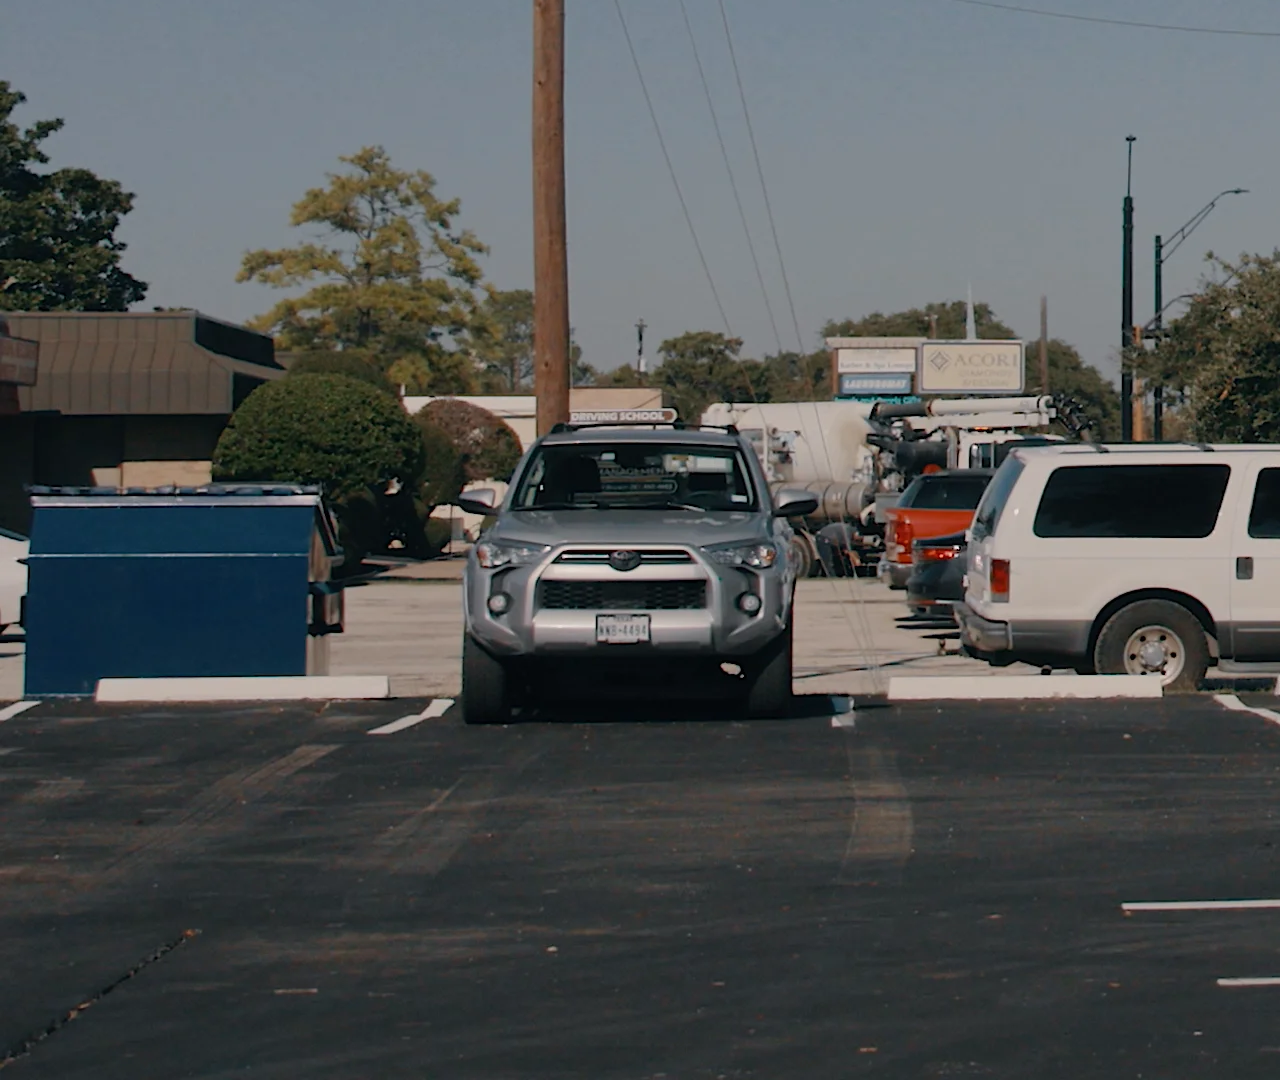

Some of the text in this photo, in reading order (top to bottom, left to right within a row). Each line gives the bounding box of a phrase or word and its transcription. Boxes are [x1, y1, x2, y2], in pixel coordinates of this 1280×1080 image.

[954, 353, 1018, 367] ACORI
[571, 411, 665, 421] DRIVING SCHOOL
